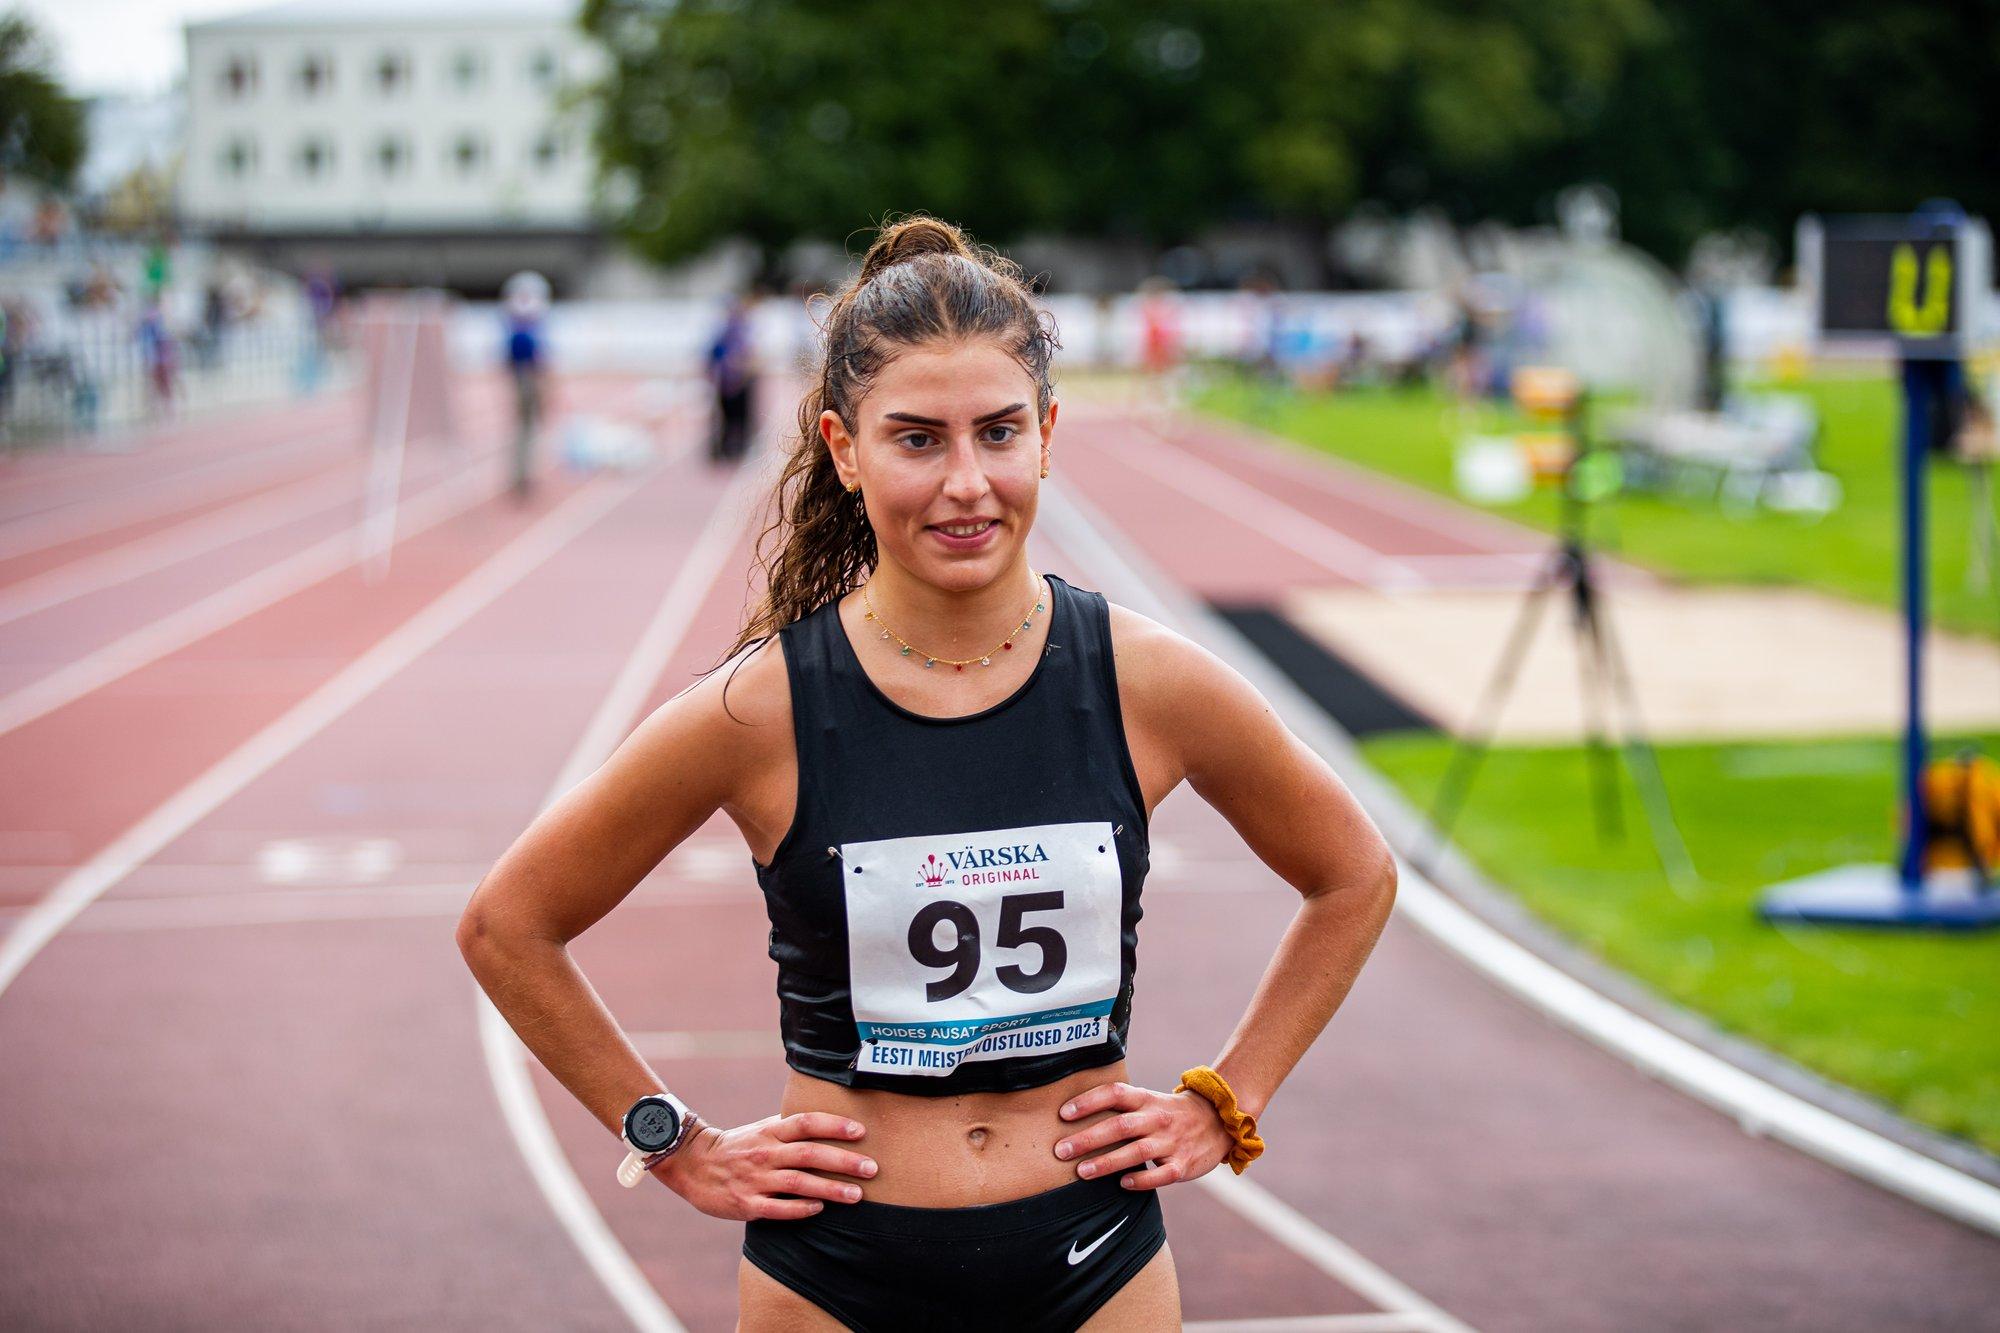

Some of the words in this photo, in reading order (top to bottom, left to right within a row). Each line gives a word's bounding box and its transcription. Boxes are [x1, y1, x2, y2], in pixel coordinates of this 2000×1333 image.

[946, 843, 1049, 870] VÄRSKA
[962, 867, 1040, 887] ORIGINAAL
[908, 890, 1067, 1003] 95
[870, 1026, 927, 1039] HOIDES
[931, 1026, 979, 1039] AUSAT
[980, 1017, 1031, 1032] SPORTI
[871, 1046, 913, 1066] EESTI
[1066, 1022, 1100, 1042] 2023
